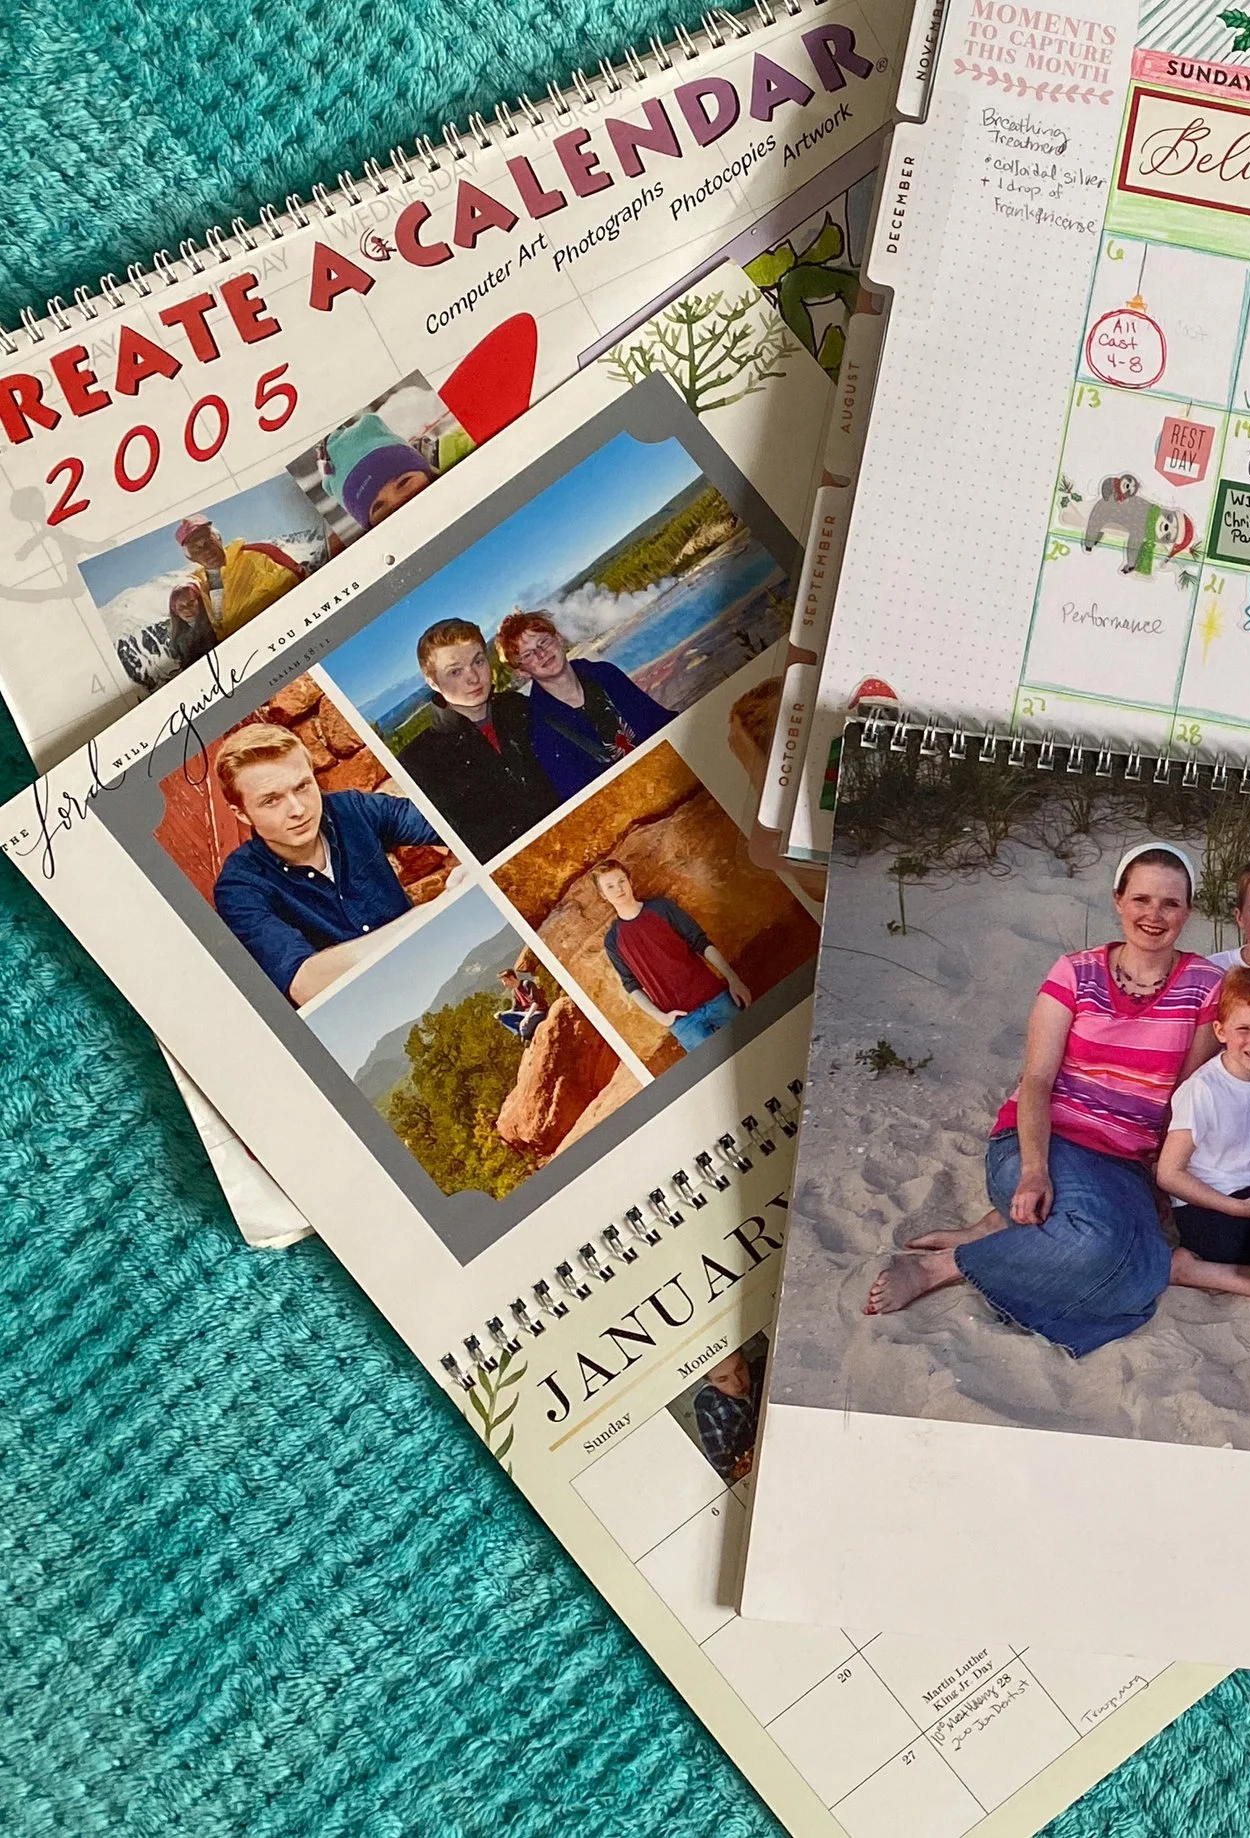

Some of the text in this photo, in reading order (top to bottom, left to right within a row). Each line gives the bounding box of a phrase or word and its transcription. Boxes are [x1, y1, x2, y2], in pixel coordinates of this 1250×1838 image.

[968, 21, 1112, 64] TO CAPTURE
[970, 0, 1116, 45] MOMENTS
[964, 40, 1110, 84] THIS MONTH
[783, 103, 852, 166] Artwork
[982, 108, 1068, 140] Breathing
[310, 242, 375, 311] A
[395, 24, 874, 267] CALENDAR
[669, 134, 776, 221] Photocopies
[1007, 180, 1041, 200] drop
[1064, 168, 1106, 188] silver
[552, 181, 664, 271] Photographs
[886, 157, 914, 254] DECEMBER
[426, 232, 548, 335] Computer Art
[1098, 334, 1137, 349] Cast
[1113, 319, 1136, 334] All
[1107, 354, 1143, 372] 4-8
[841, 361, 860, 433] AUGUST
[46, 363, 297, 525] 2005
[1171, 423, 1206, 449] REST
[1169, 449, 1197, 472] DAY
[803, 514, 836, 626] SEPTEMBER
[1062, 602, 1166, 635] Performance
[269, 661, 300, 686] ISAIAH
[0, 582, 359, 879] THE Lord WILL guide YOU ALWAYS
[779, 702, 805, 786] OCTOBER
[676, 1335, 730, 1380] Monday
[582, 1411, 631, 1454] Sunday
[922, 1648, 988, 1704] Martin Luther
[933, 1689, 959, 1712] King
[972, 1660, 993, 1680] Day
